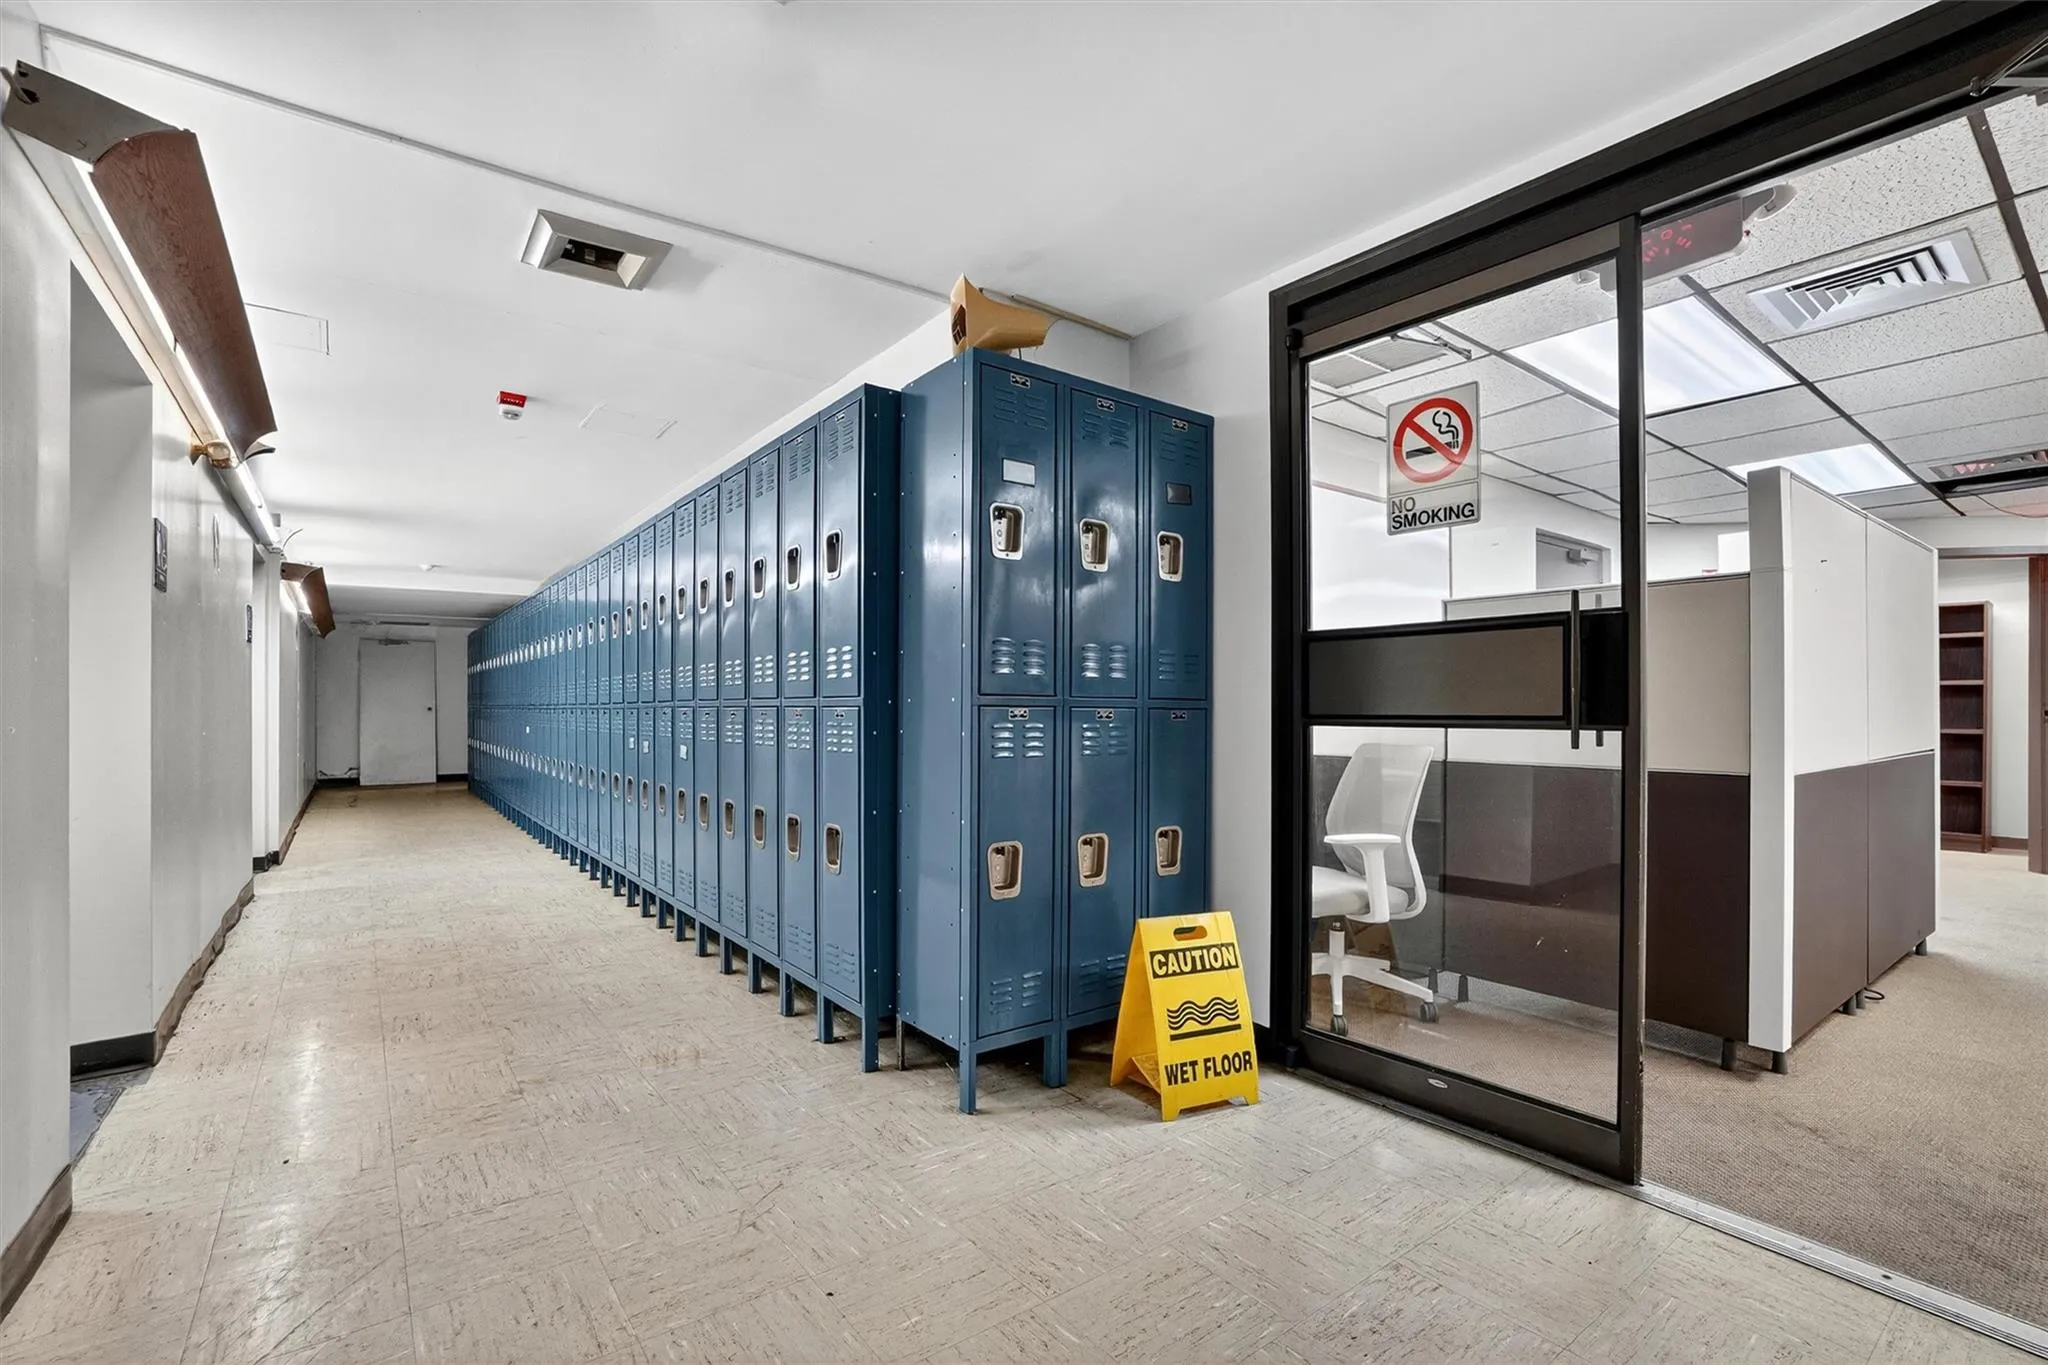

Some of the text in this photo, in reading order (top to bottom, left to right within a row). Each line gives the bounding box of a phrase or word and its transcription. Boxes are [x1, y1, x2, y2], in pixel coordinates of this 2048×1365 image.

[1392, 497, 1416, 515] NO
[1392, 502, 1475, 530] SMOKING
[1152, 945, 1237, 976] CAUTION
[1164, 1050, 1253, 1086] WET FLOOR
